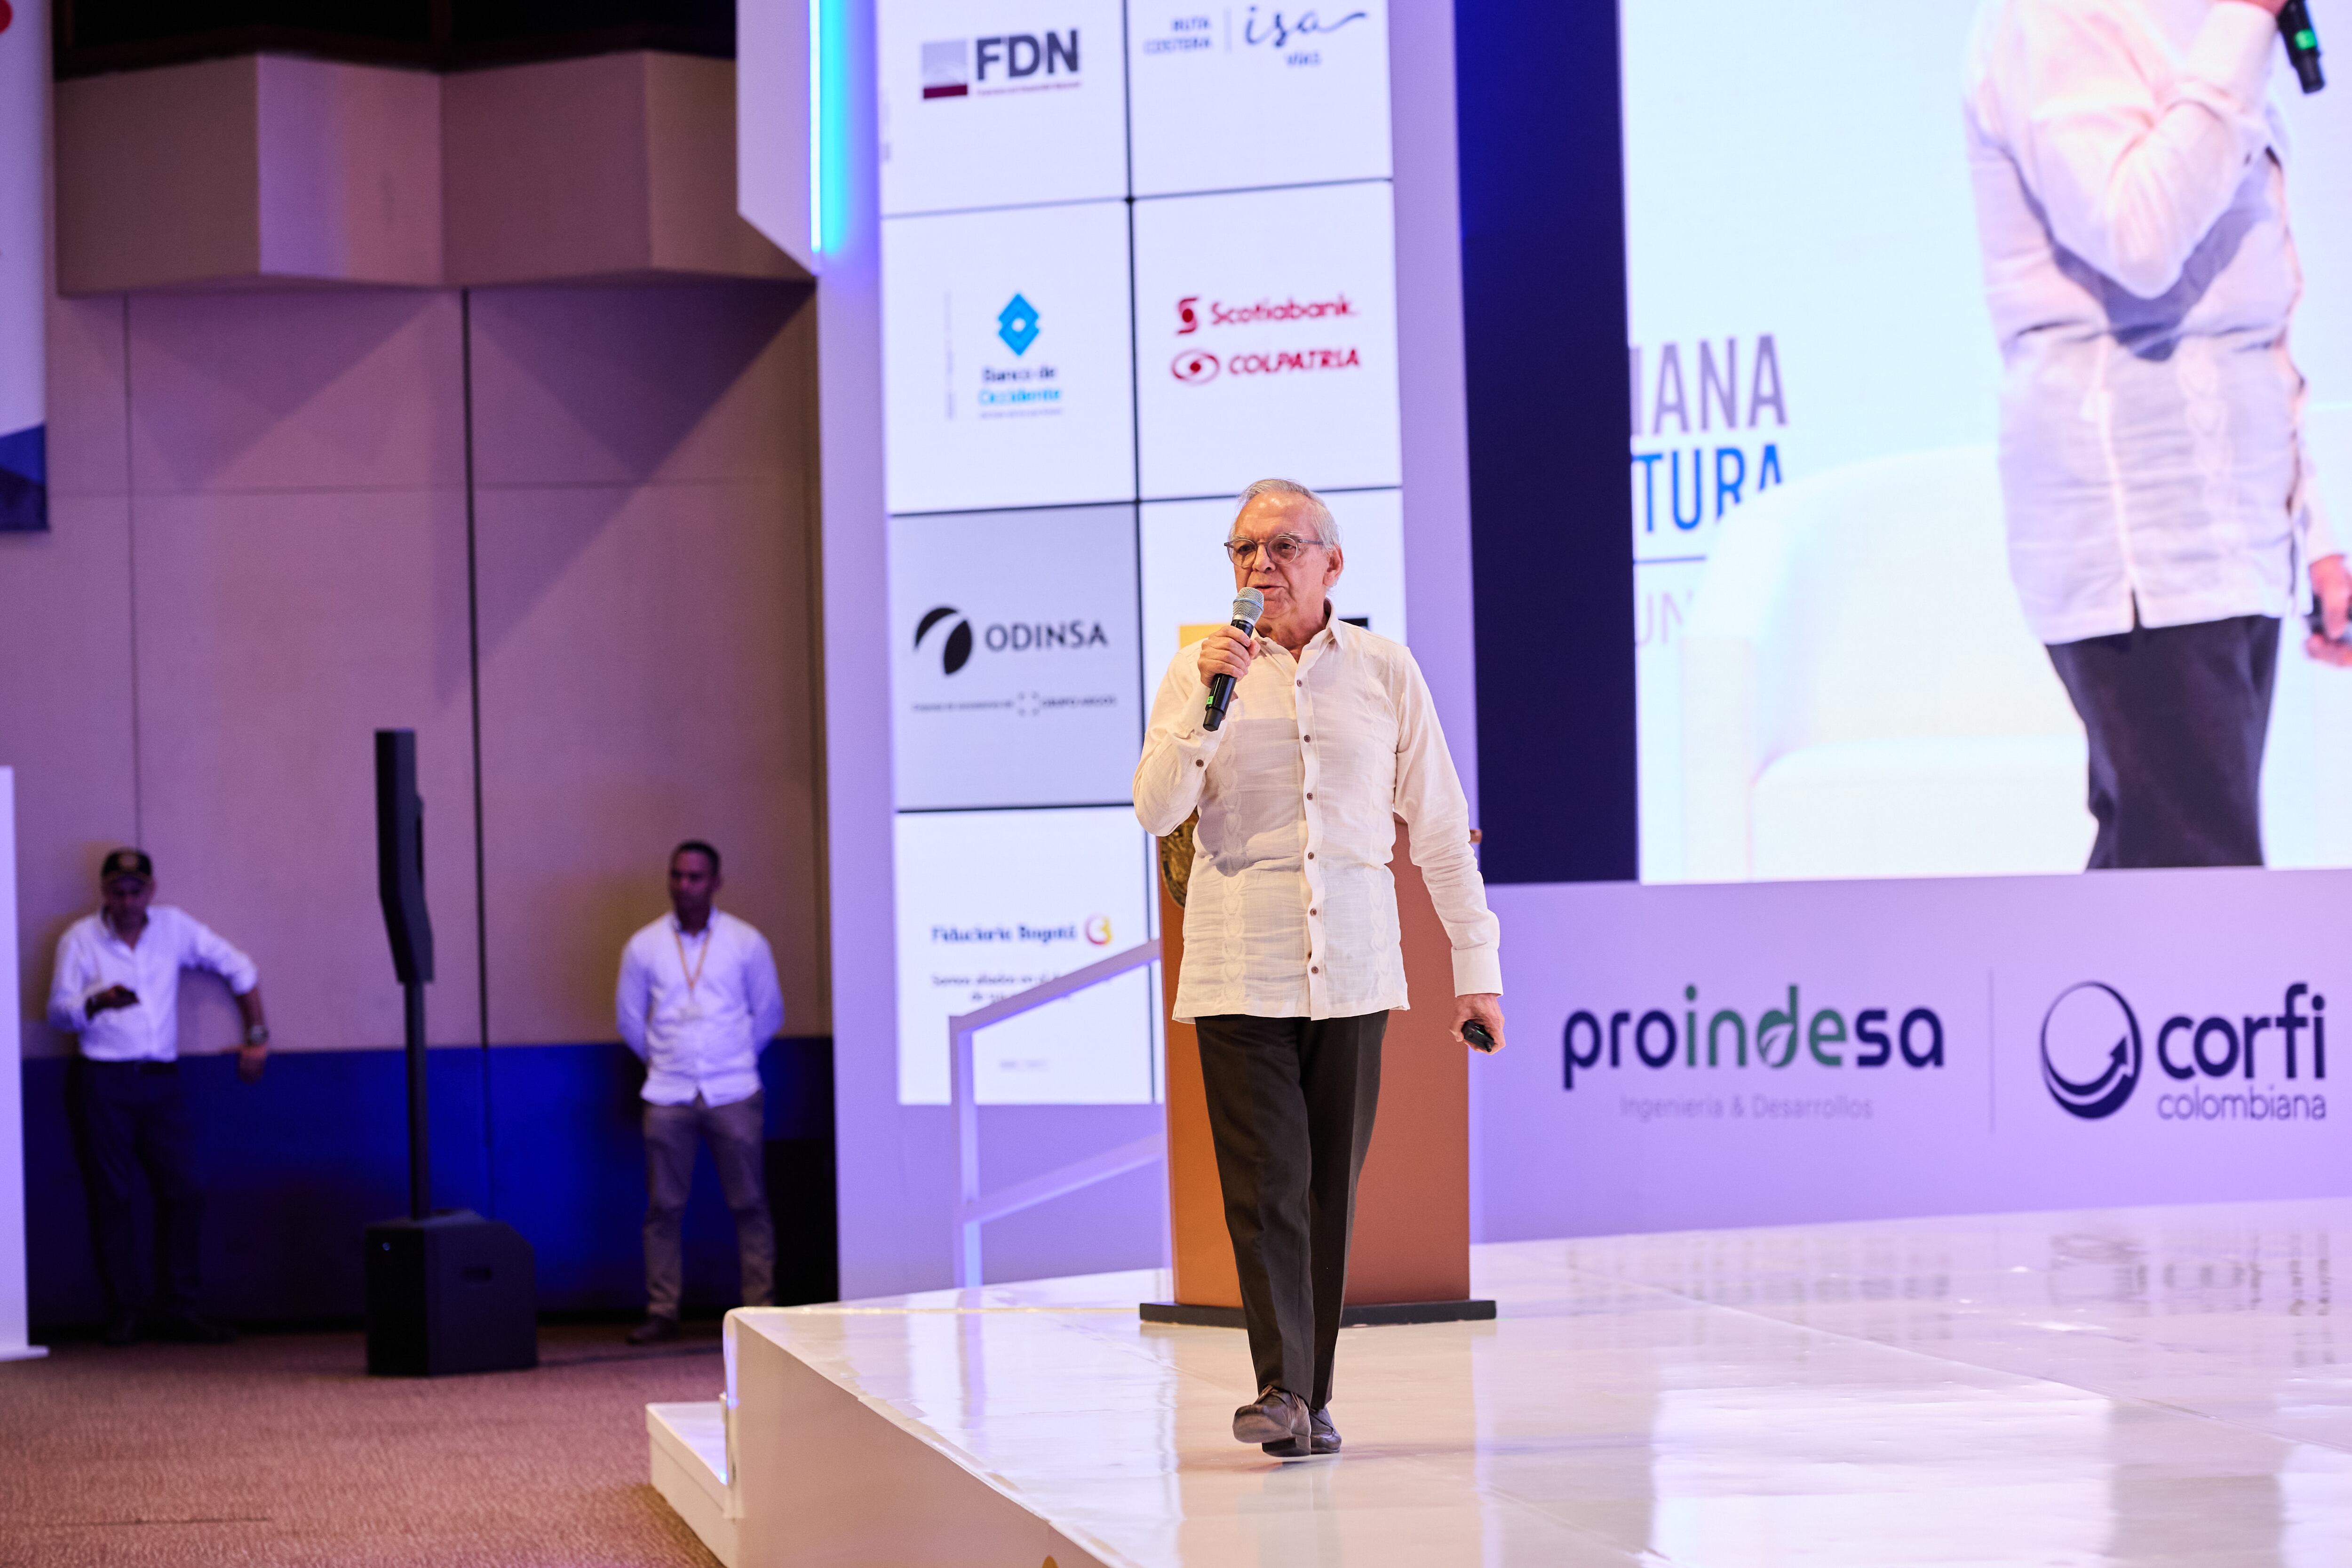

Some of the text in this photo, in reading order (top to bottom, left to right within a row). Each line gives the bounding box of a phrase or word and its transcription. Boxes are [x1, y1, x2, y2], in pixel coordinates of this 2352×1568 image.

[977, 29, 1078, 81] FDN
[985, 619, 1109, 652] ODINSA
[1563, 984, 1945, 1091] proindesa
[2157, 981, 2326, 1080] corfi
[1752, 1094, 1874, 1119] Desarrollos
[2157, 1085, 2327, 1121] colombiana
